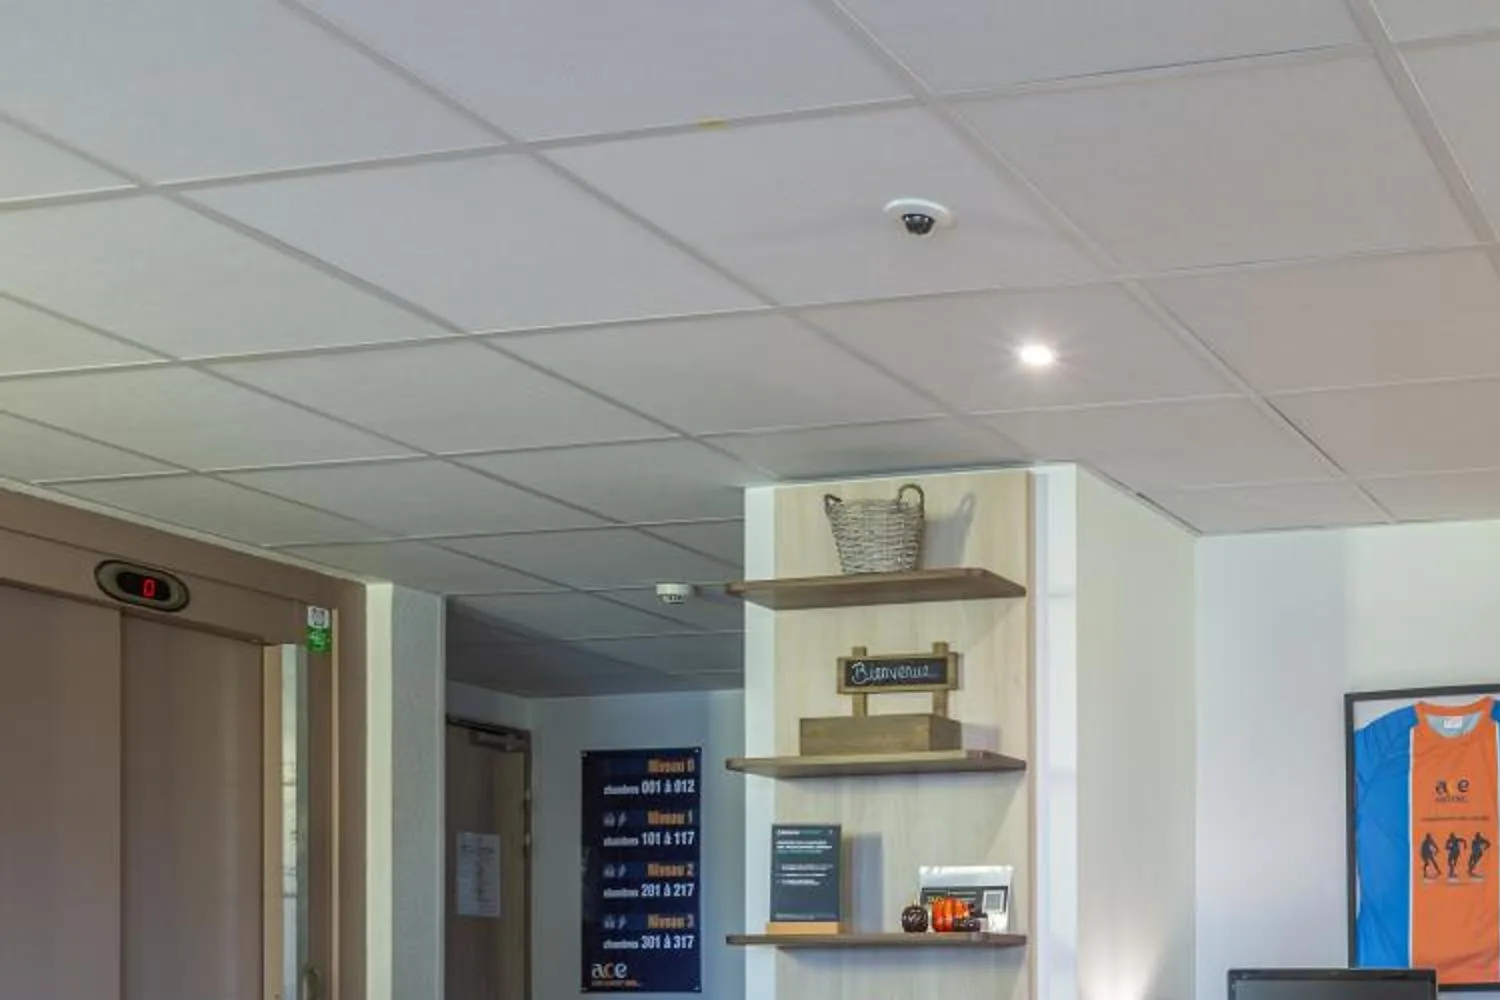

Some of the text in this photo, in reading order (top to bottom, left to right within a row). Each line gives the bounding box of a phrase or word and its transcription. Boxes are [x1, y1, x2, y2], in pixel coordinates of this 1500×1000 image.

[143, 578, 156, 598] 0
[674, 779, 695, 793] 012
[642, 832, 661, 845] 101
[674, 831, 695, 845] 117
[641, 883, 661, 897] 201
[673, 883, 695, 896] 217
[641, 935, 661, 949] 301
[673, 935, 695, 948] 317
[591, 963, 628, 979] ace
